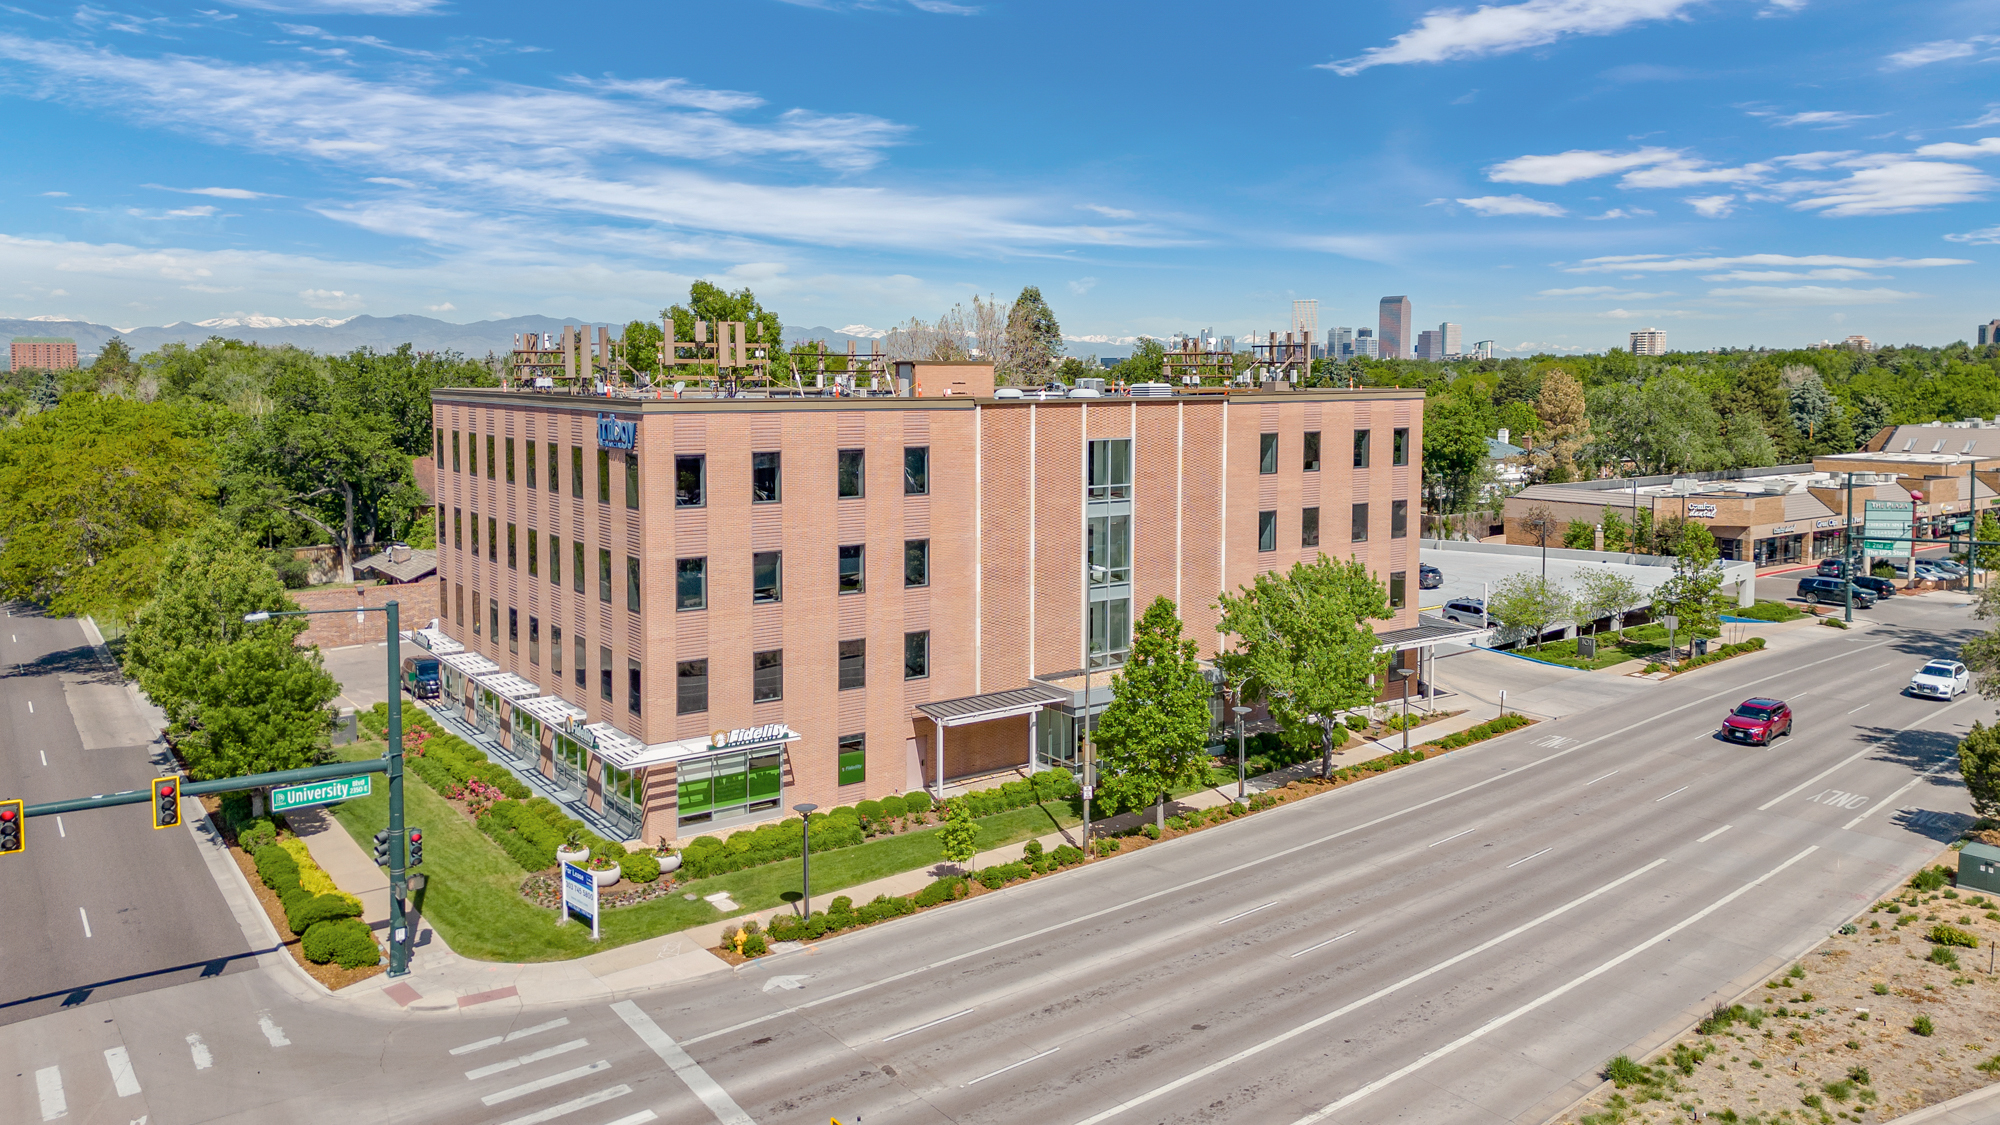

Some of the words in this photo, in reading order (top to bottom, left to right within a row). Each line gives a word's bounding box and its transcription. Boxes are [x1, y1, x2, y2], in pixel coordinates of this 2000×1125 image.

[1688, 502, 1716, 510] Comfort
[729, 724, 789, 743] Fidelity
[287, 783, 349, 804] University
[1806, 789, 1870, 810] ONLY
[572, 869, 584, 881] Lease
